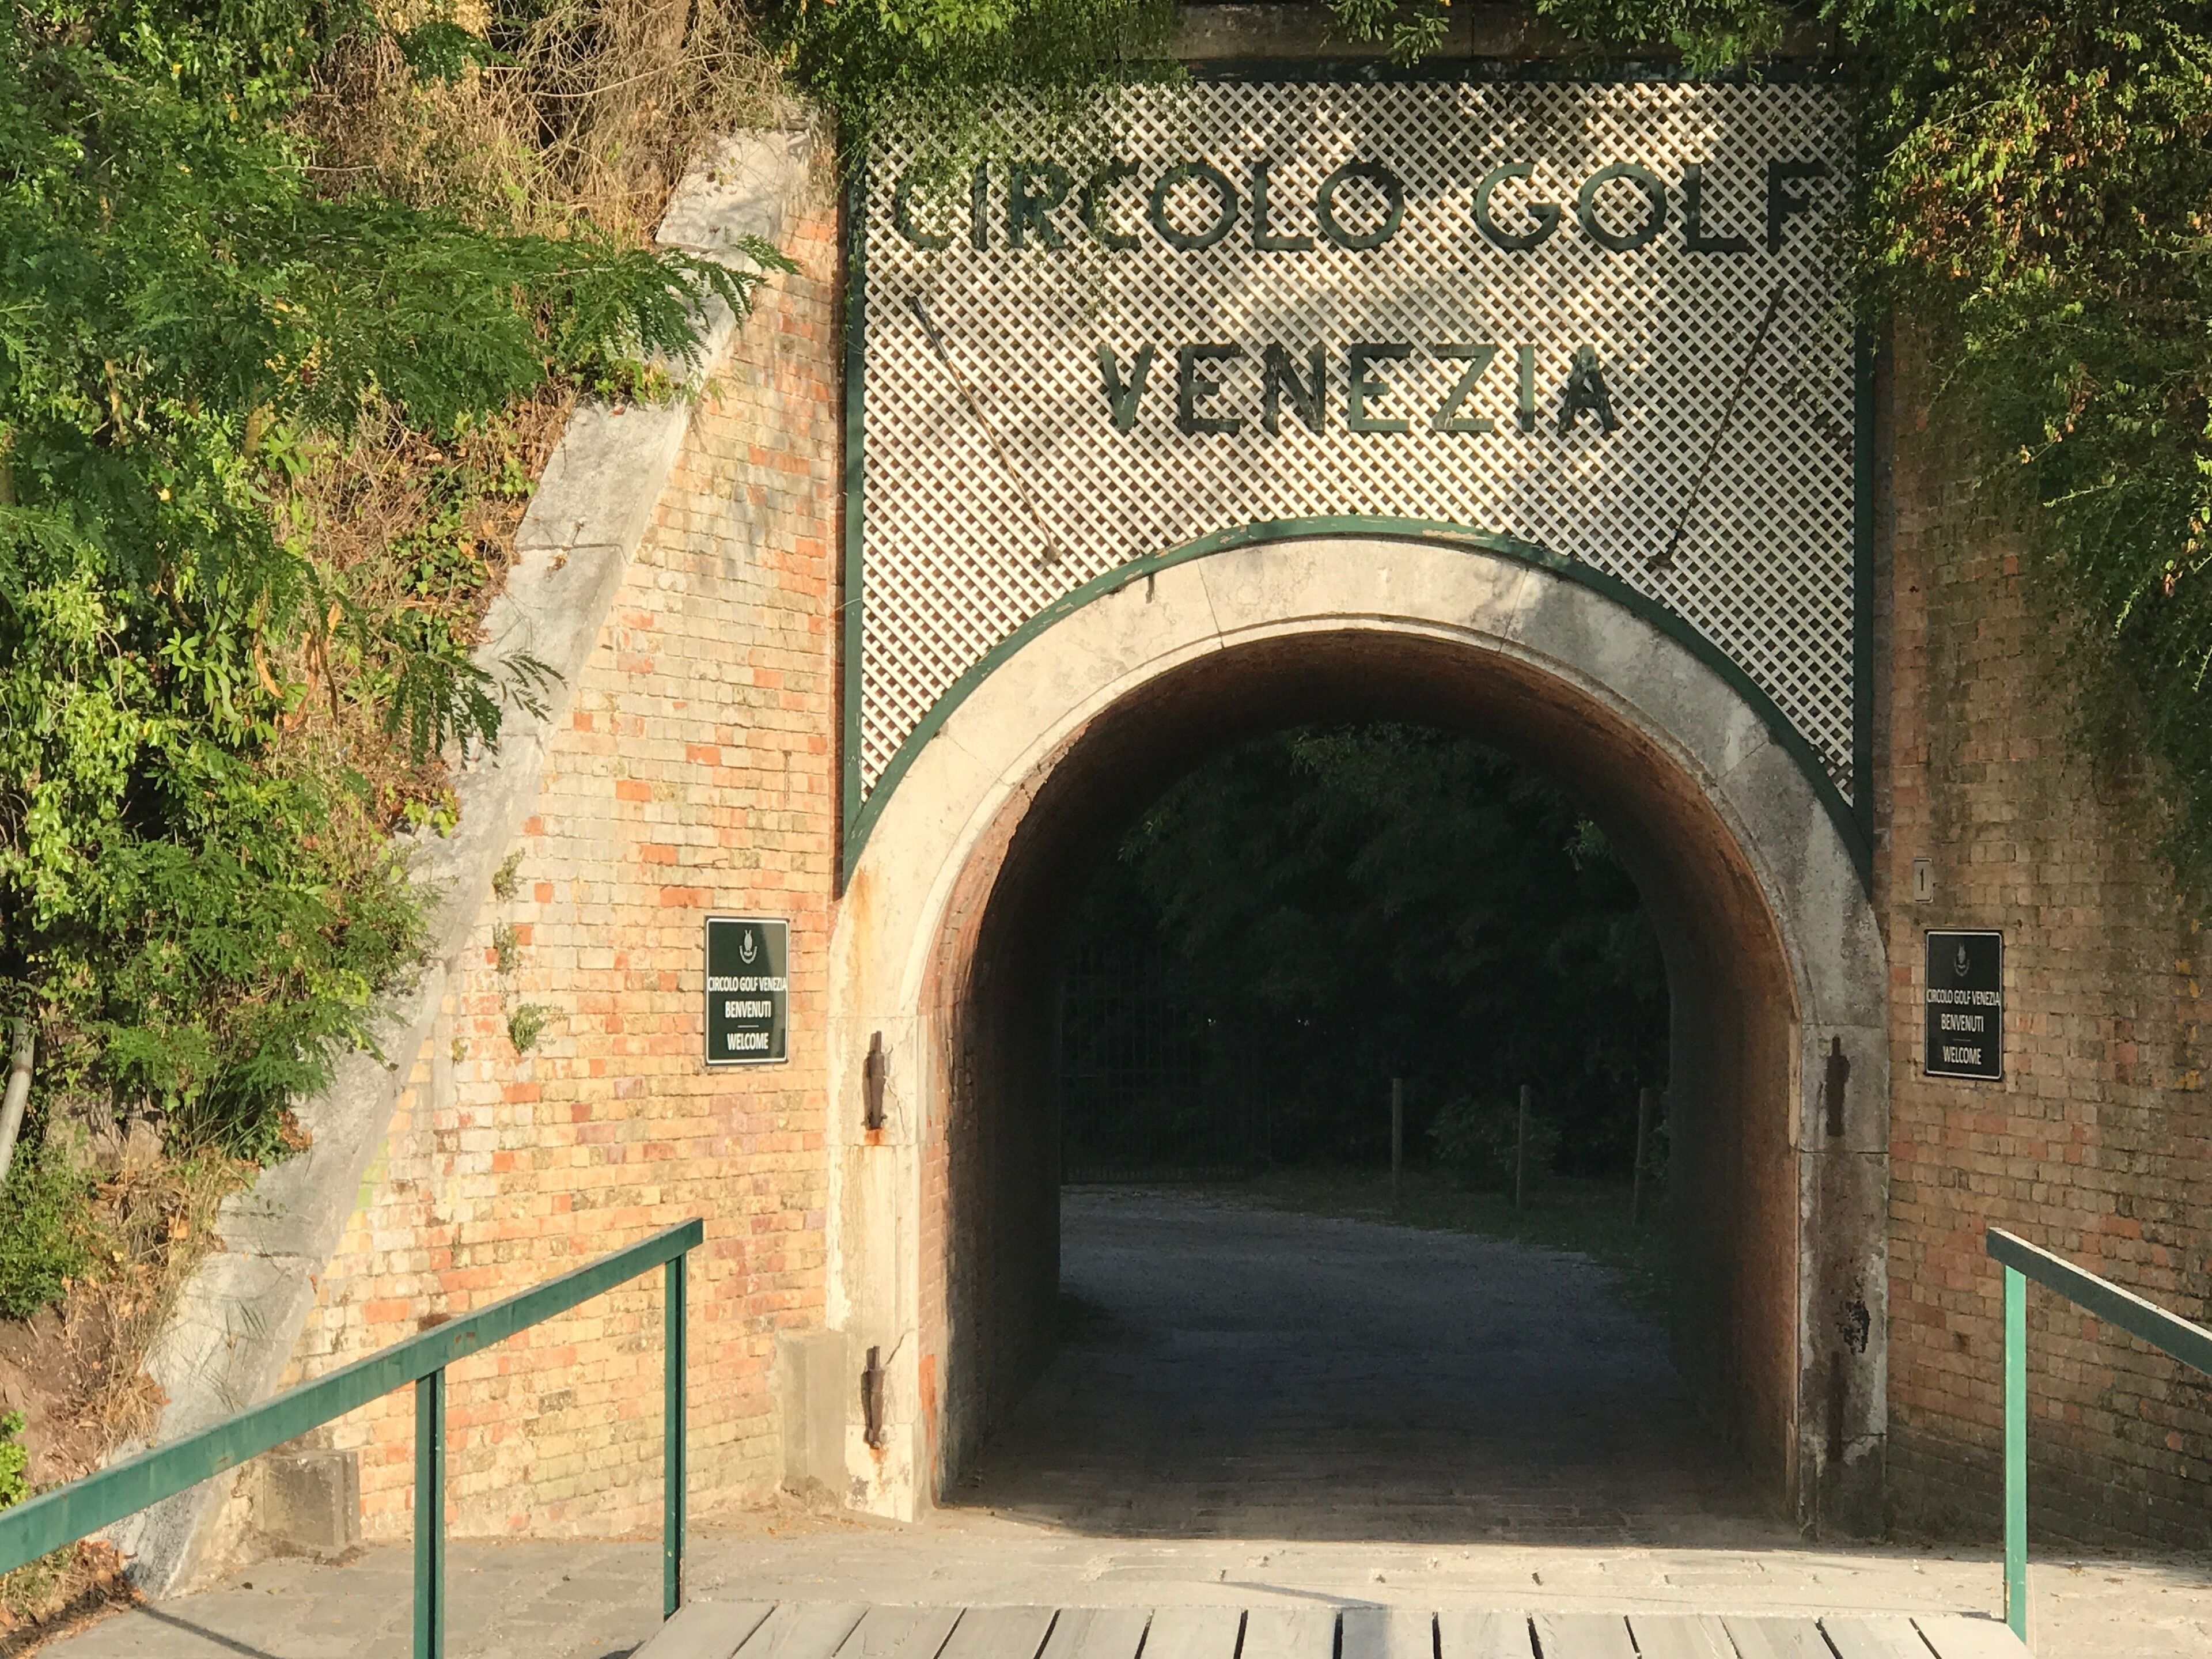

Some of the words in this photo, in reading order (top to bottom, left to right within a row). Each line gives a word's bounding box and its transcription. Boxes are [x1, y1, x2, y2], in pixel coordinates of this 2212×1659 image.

[896, 161, 1405, 252] CIRCOLO
[1473, 162, 1831, 252] GOLF
[1097, 343, 1614, 433] VENEZIA
[1919, 868, 1924, 891] 1
[708, 976, 738, 991] CIRCOLO
[740, 977, 758, 991] GOLF
[759, 977, 787, 991] VENEZIA
[1927, 989, 1953, 1004] CIRCOLO
[1954, 990, 1971, 1005] GOLF
[1972, 991, 2000, 1006] VENEZIA
[725, 1001, 771, 1018] BENVENUTI
[1941, 1014, 1984, 1032] BENVENUTI
[726, 1033, 769, 1051] WELCOME
[1942, 1046, 1982, 1065] WELCOME
